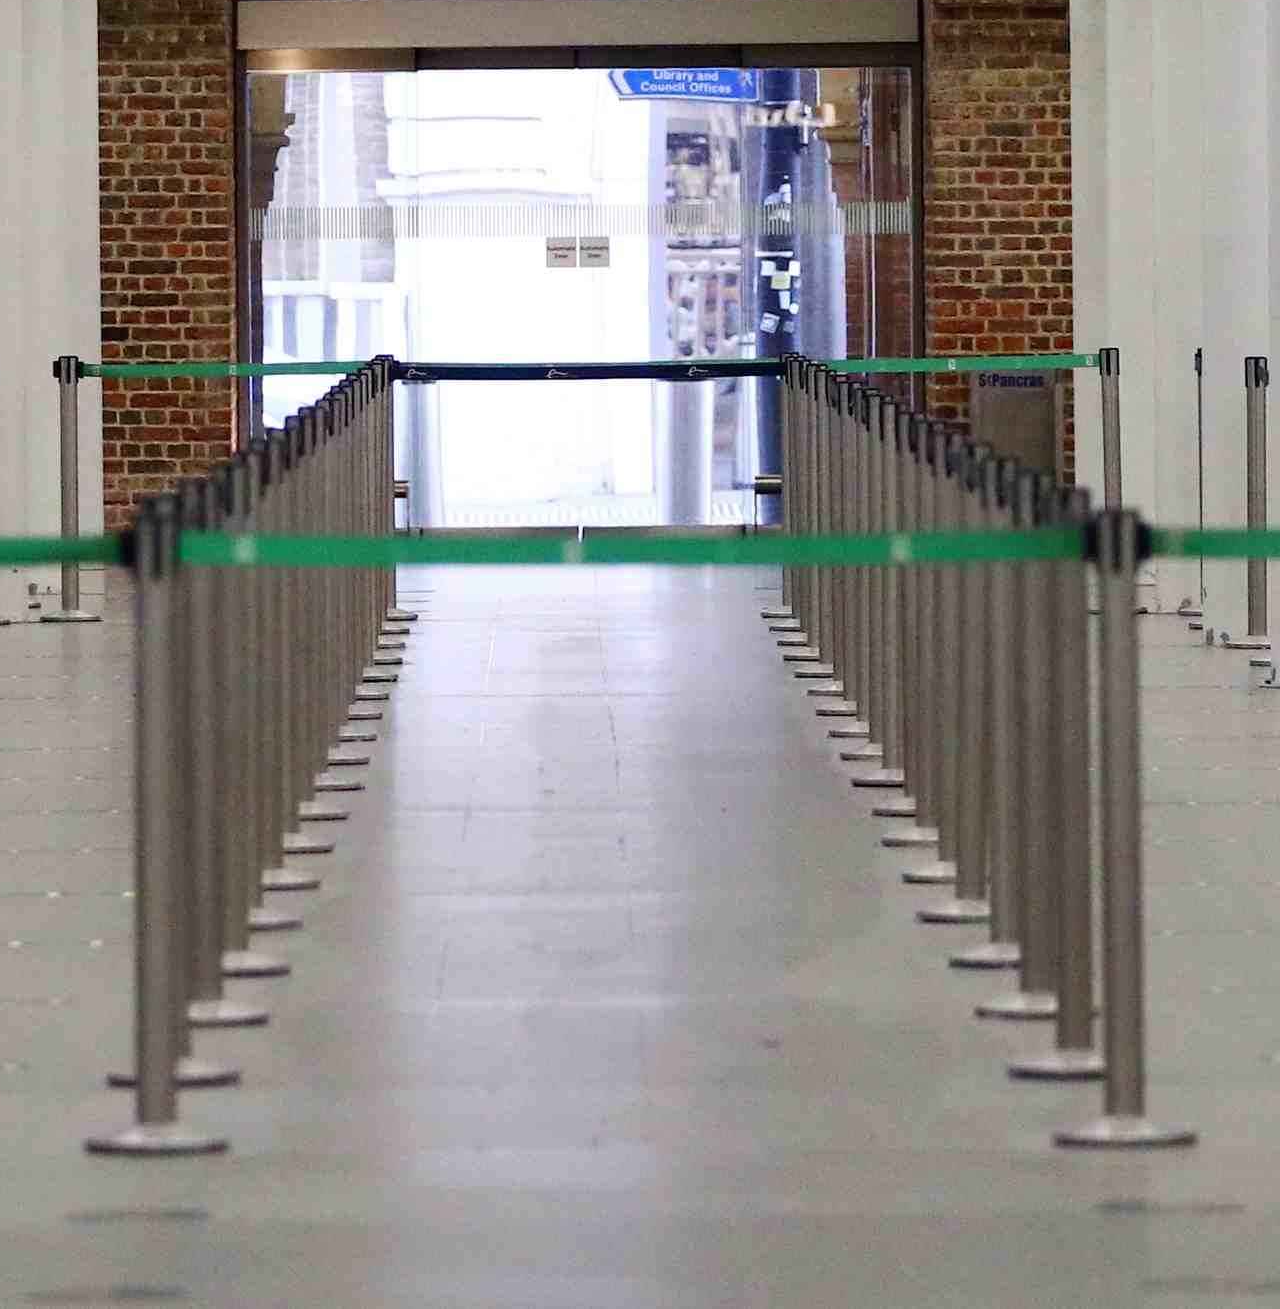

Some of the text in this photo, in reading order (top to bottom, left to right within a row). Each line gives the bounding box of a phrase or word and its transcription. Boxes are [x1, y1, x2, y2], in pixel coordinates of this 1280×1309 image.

[653, 70, 719, 83] Library and
[640, 81, 732, 94] Council Offices
